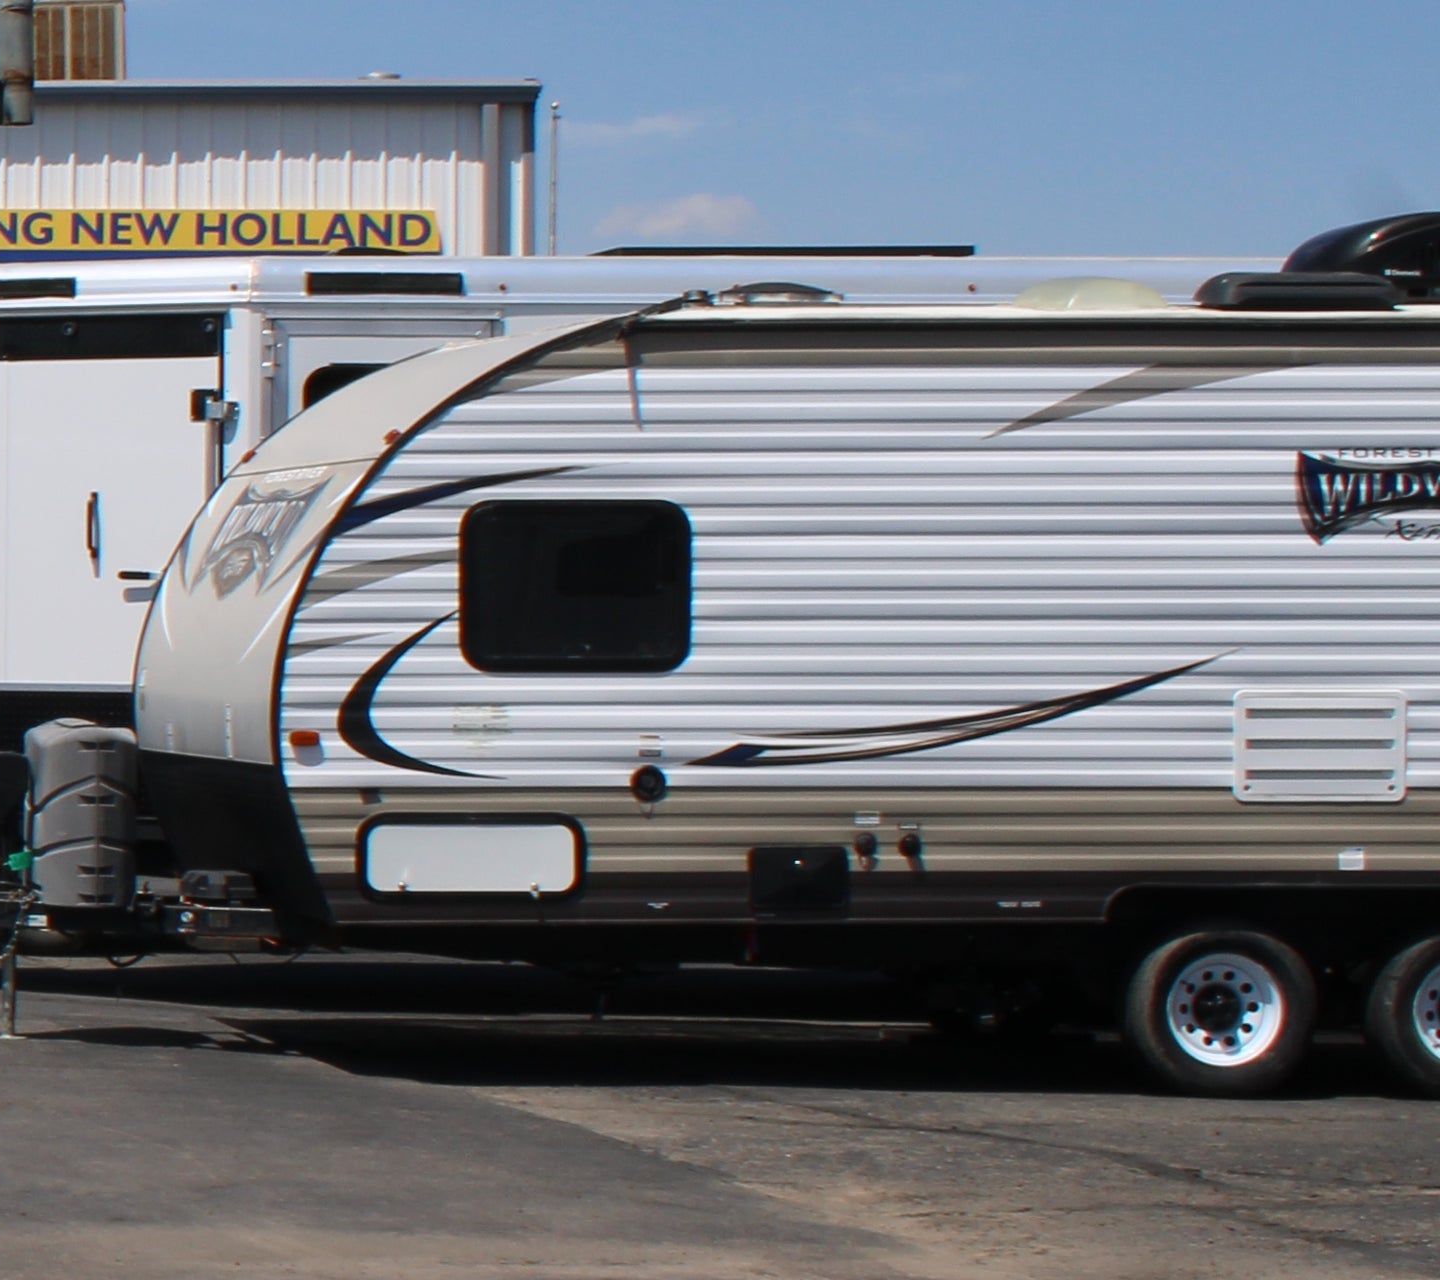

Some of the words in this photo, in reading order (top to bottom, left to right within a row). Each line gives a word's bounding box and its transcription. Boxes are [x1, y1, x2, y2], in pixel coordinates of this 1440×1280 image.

[71, 212, 180, 245] NEW
[195, 212, 433, 246] HOLLAND
[1338, 447, 1433, 459] FOREST
